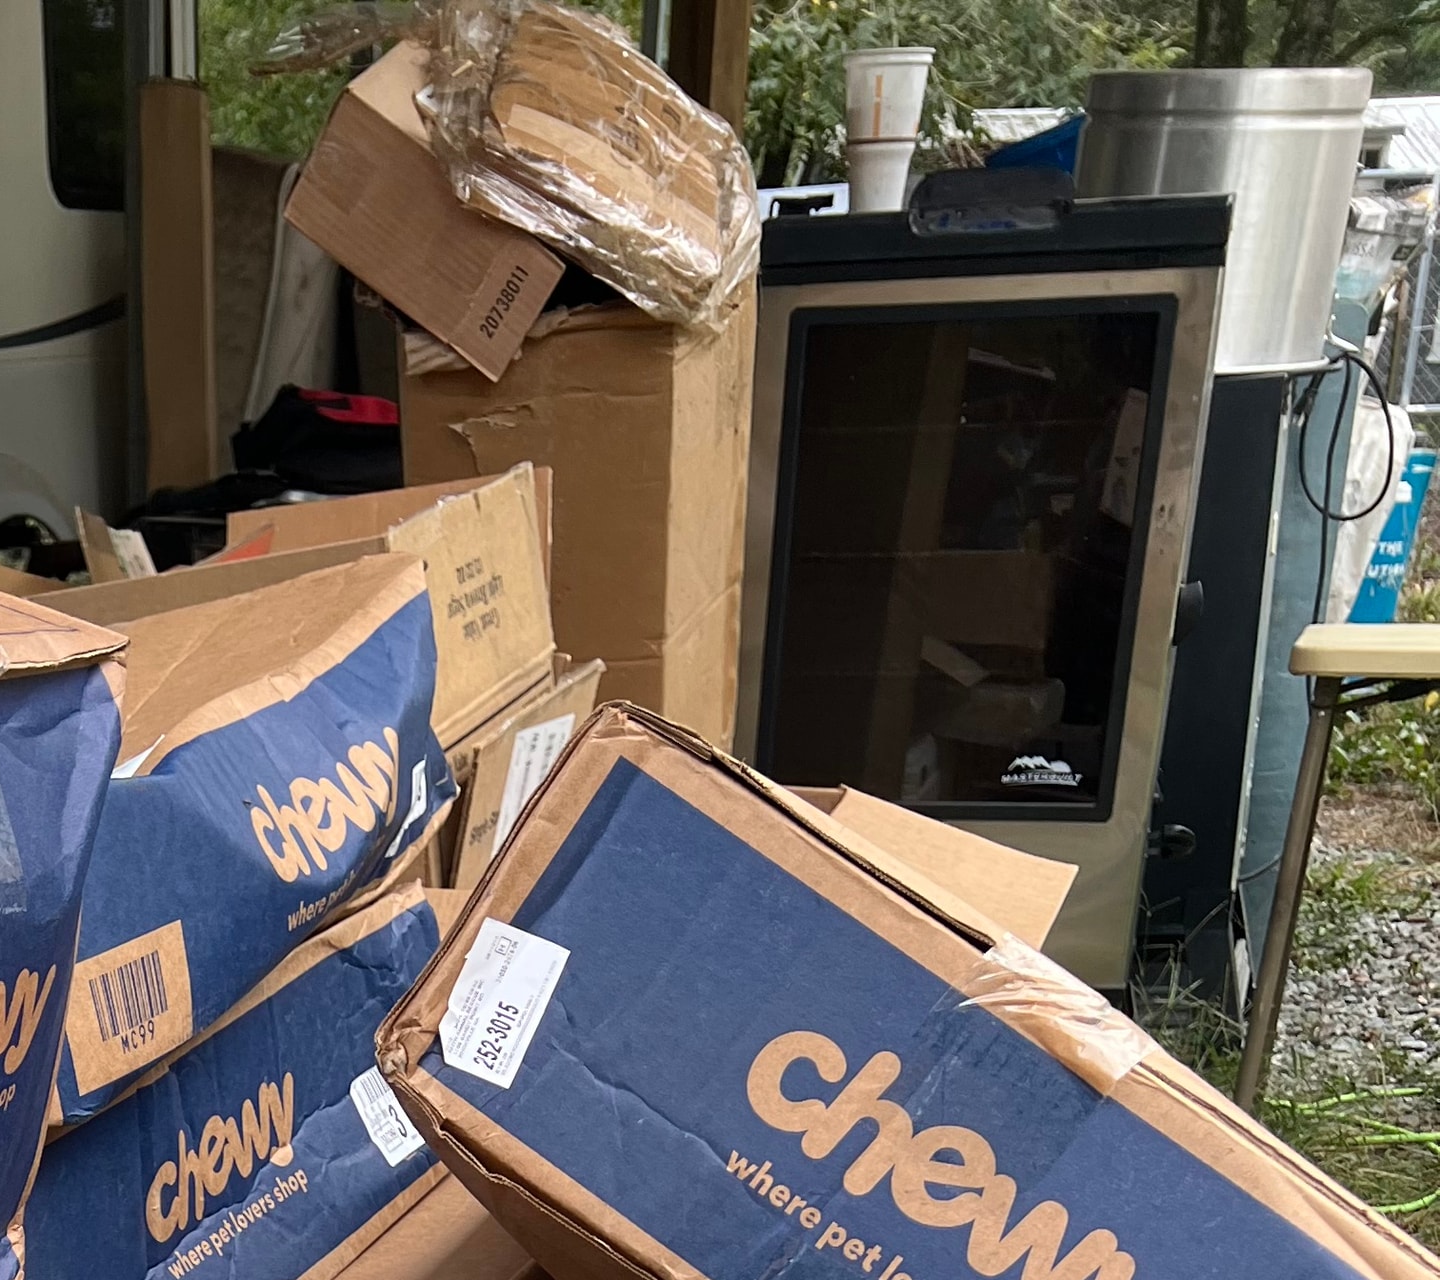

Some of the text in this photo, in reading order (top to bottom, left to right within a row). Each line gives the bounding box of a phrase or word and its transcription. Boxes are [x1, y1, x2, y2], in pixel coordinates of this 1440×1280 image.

[478, 263, 529, 340] 20738011
[251, 726, 399, 883] chewy
[120, 1021, 156, 1055] MC99
[473, 1000, 520, 1070] 252-3015
[146, 1072, 294, 1243] chewy
[727, 1147, 822, 1231] where
[817, 1219, 882, 1274] pet
[168, 1169, 309, 1280] where pet lovers shop
